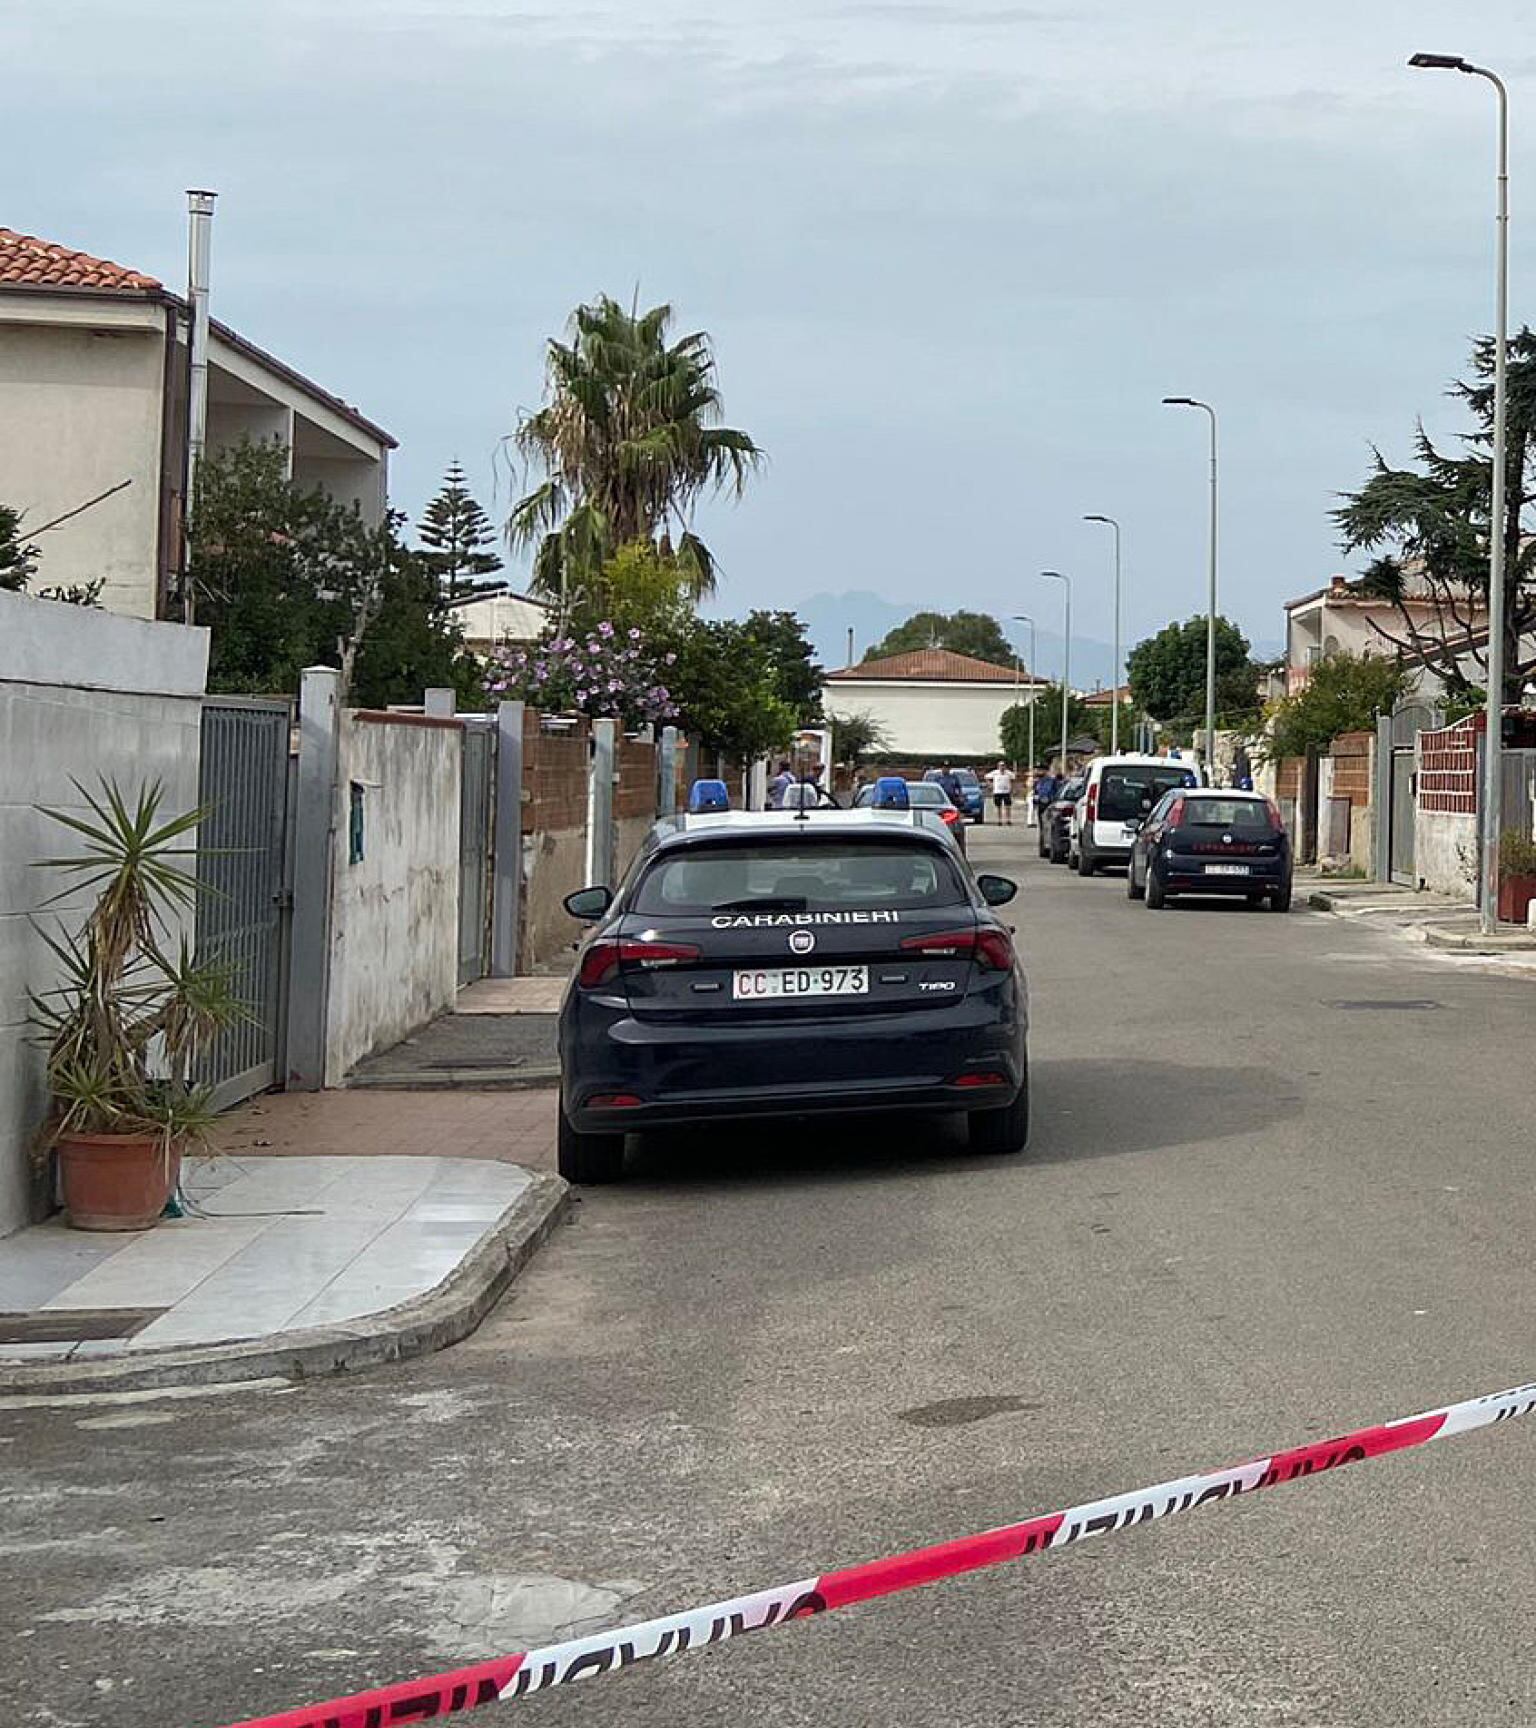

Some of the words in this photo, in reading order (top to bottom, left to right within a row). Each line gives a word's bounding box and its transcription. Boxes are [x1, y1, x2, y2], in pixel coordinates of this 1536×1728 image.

[711, 911, 899, 928] CARABINIERI
[738, 973, 767, 996] CC
[782, 970, 811, 994] ED
[820, 966, 864, 992] 973
